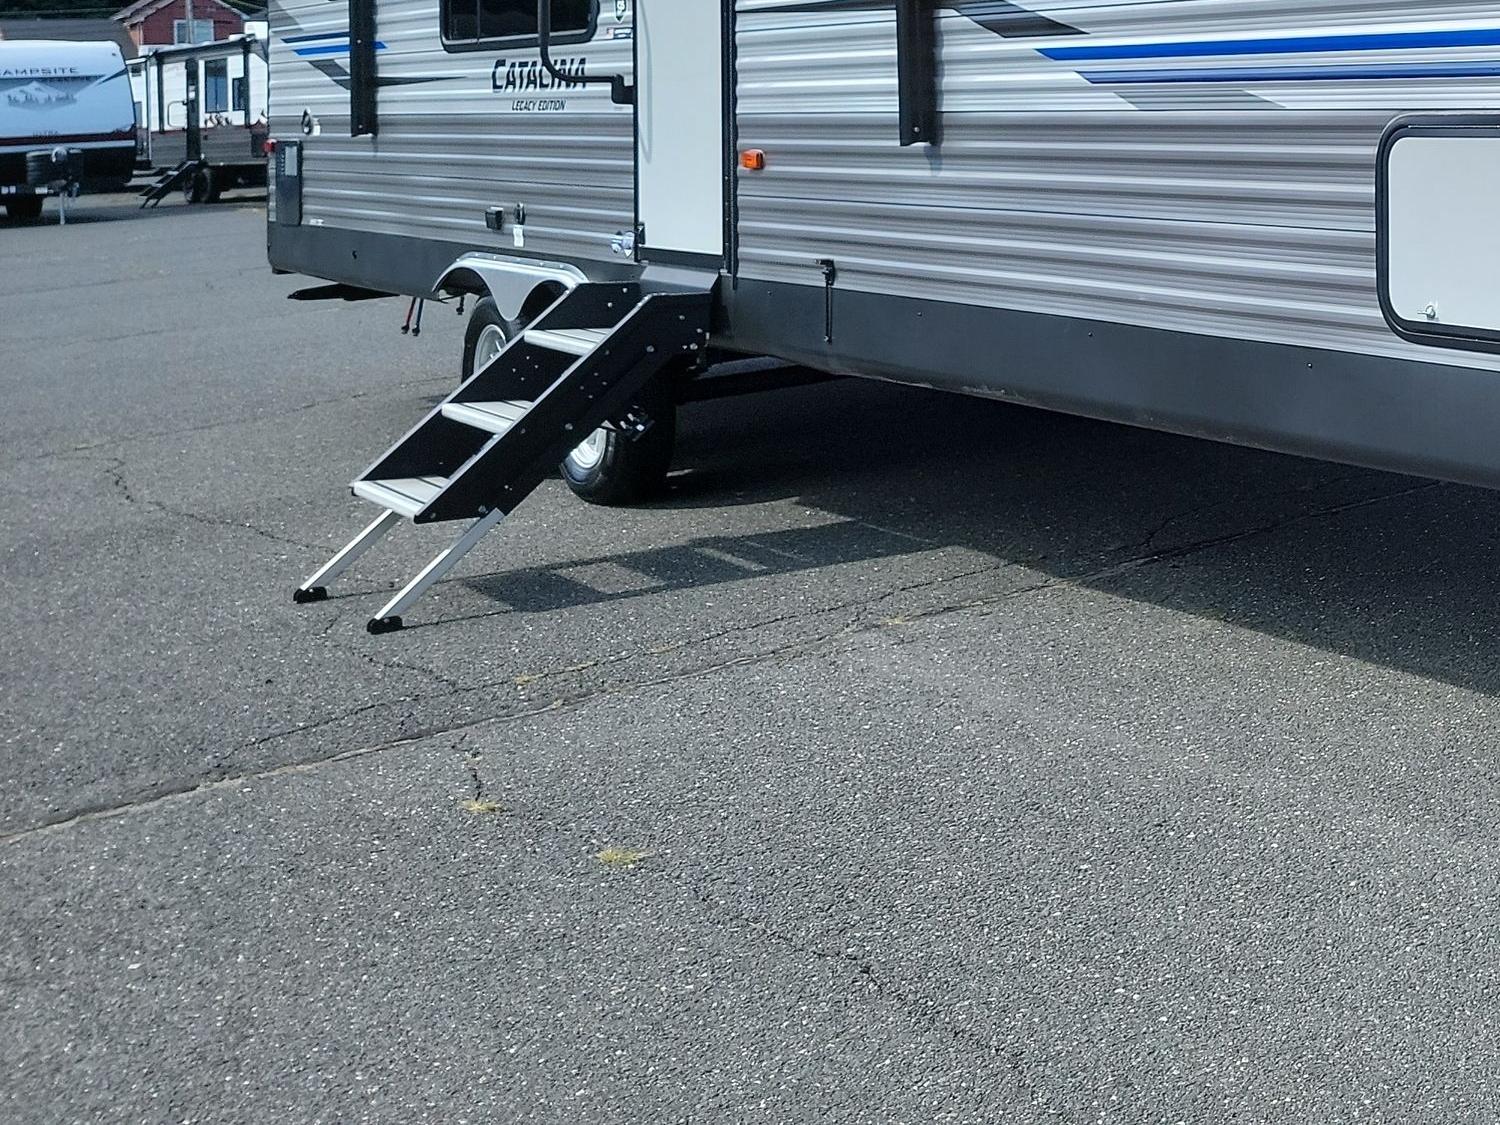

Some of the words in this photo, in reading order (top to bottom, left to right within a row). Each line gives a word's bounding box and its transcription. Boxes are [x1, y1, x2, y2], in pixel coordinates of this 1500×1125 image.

[0, 66, 79, 76] AMPSITE
[491, 57, 587, 93] CATALINA
[511, 100, 537, 111] LEGACY
[538, 100, 567, 111] EDITION
